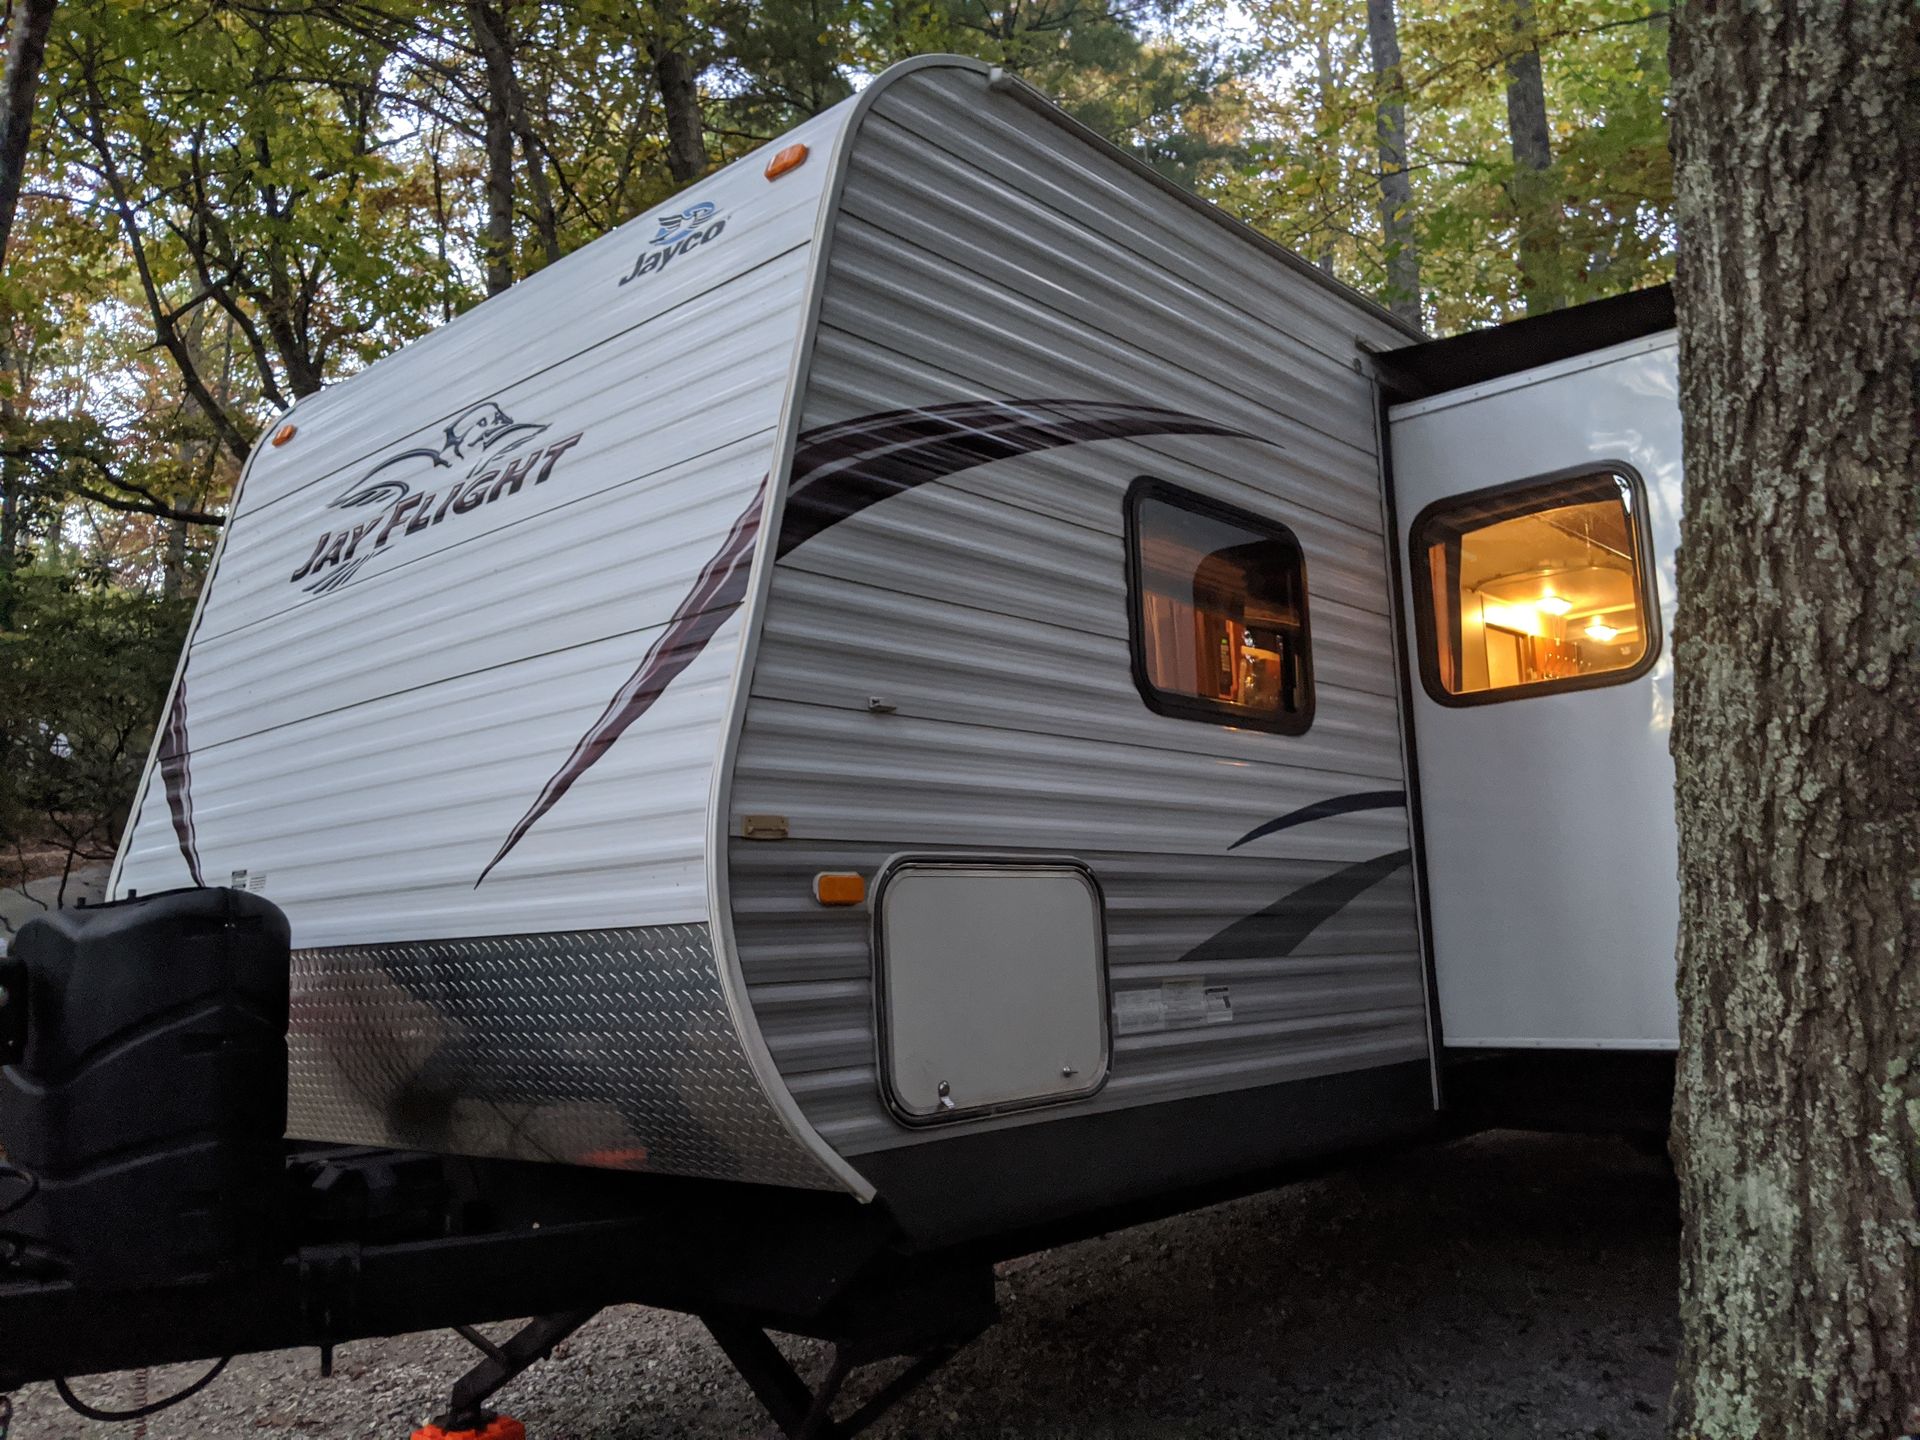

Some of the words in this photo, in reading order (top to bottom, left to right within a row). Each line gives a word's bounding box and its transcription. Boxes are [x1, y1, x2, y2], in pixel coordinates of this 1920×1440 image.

[618, 219, 726, 287] Jayco
[289, 506, 384, 583] JAY
[373, 431, 584, 549] FLIGHT
